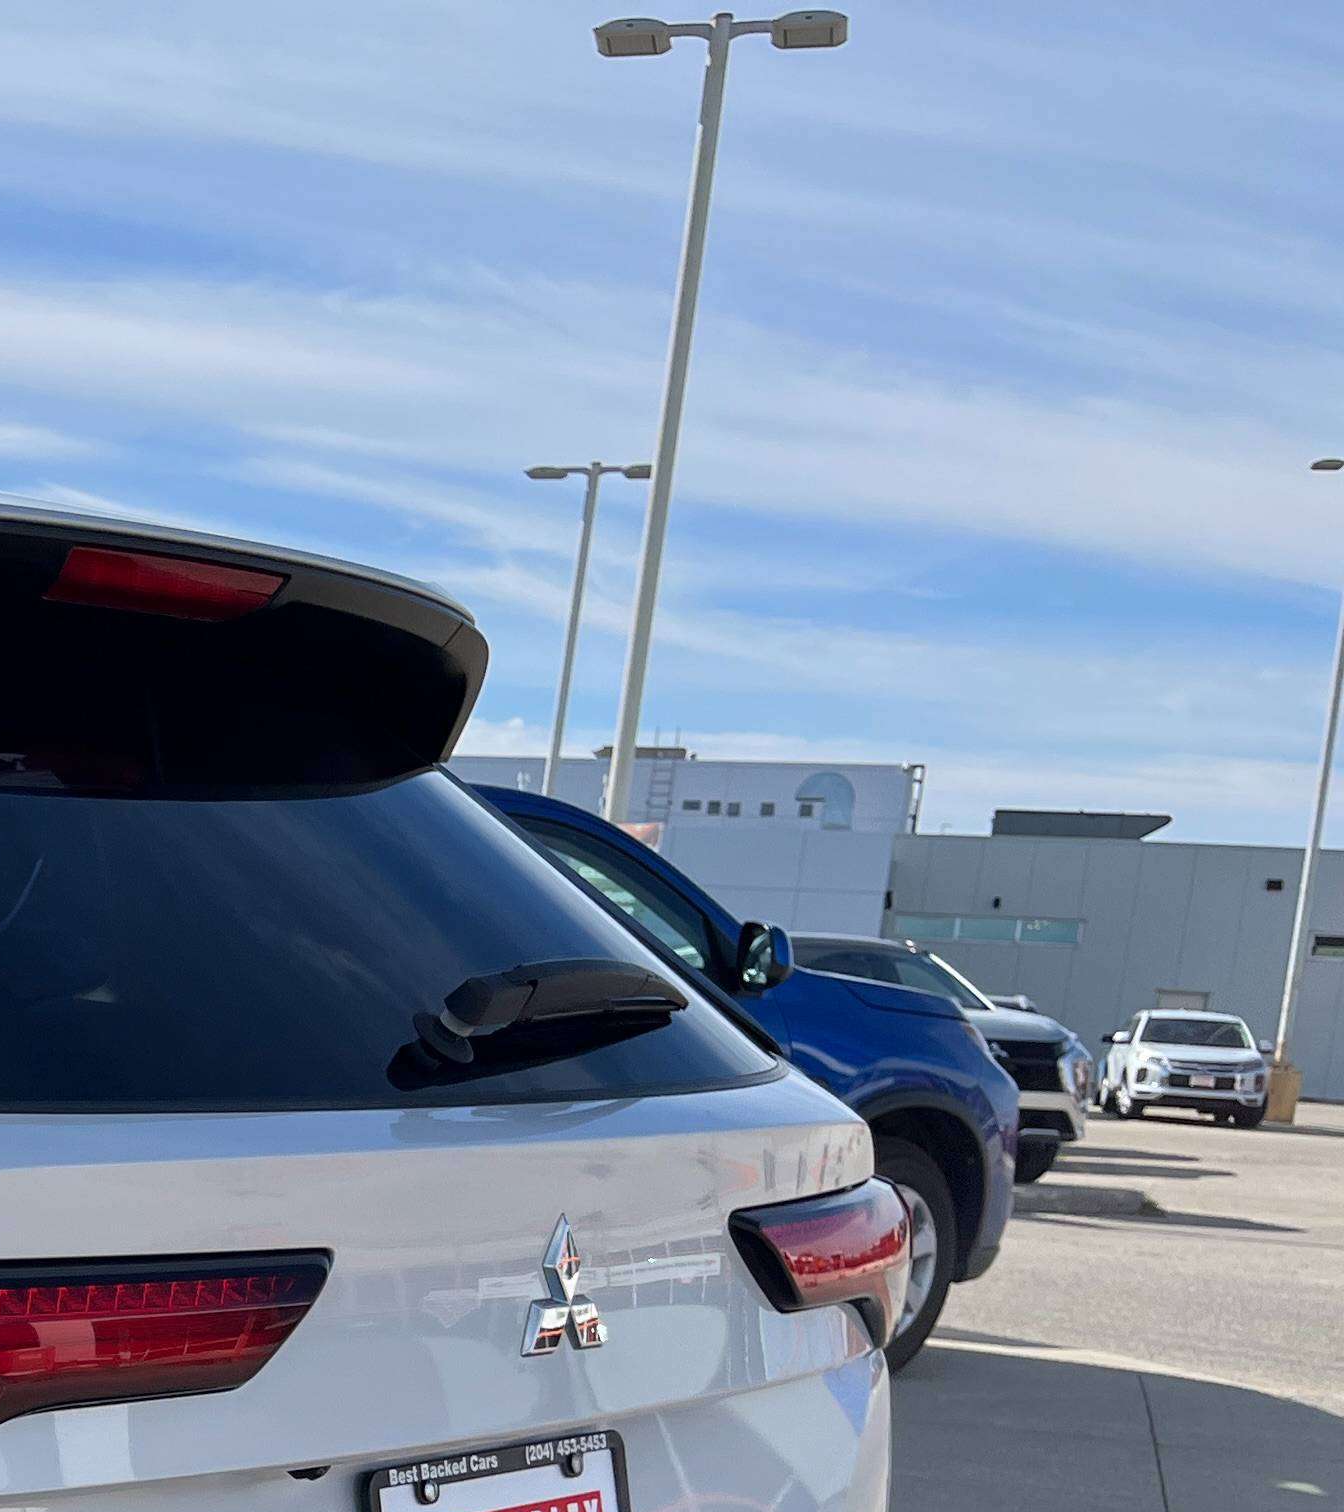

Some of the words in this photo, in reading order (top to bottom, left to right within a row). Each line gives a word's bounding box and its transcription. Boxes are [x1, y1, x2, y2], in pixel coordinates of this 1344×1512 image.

[525, 1441, 555, 1466] (204)
[388, 1464, 419, 1486] Best
[420, 1456, 467, 1481] Backed
[470, 1454, 499, 1473] Cars
